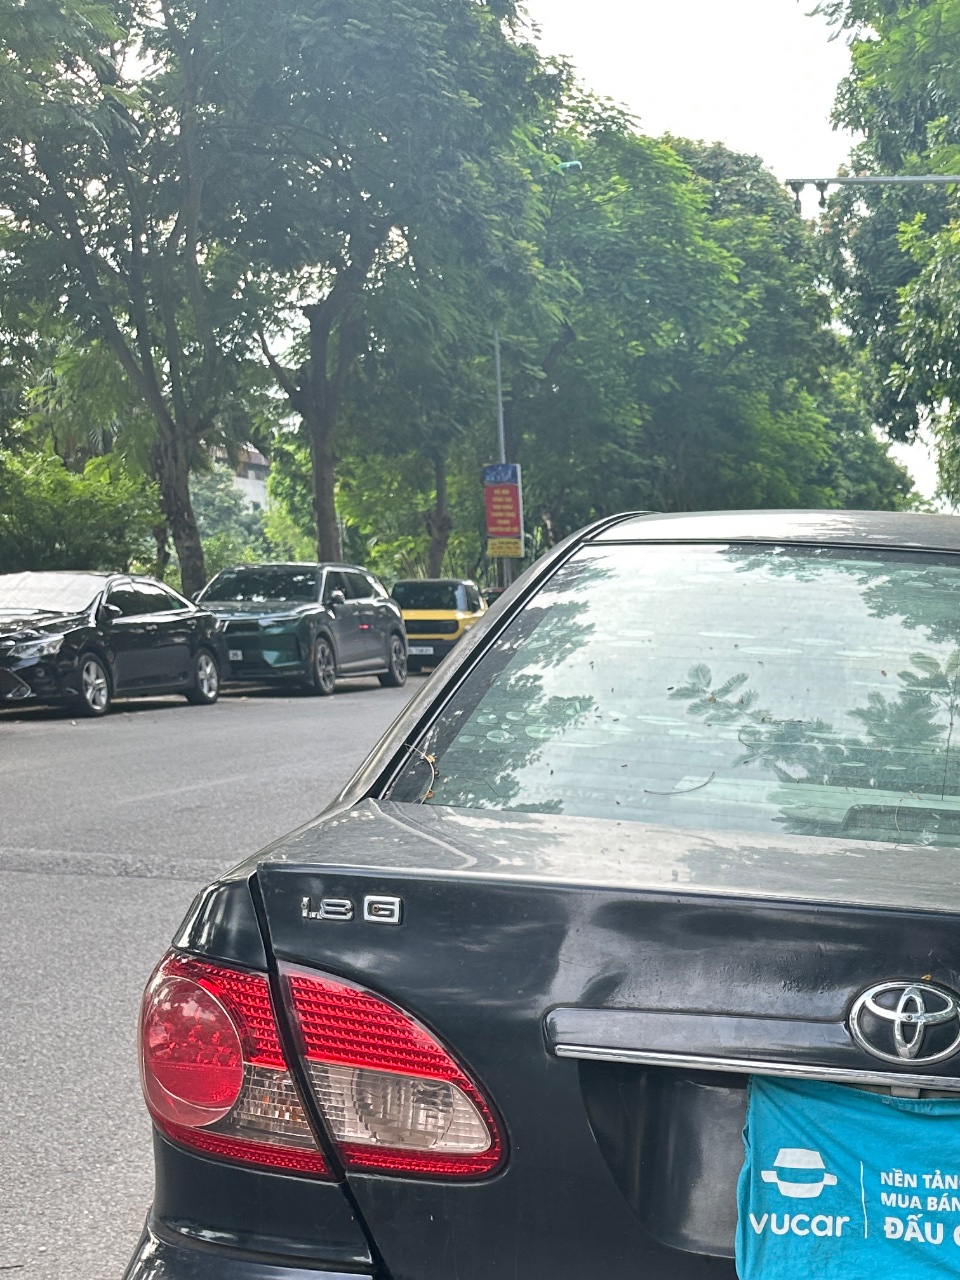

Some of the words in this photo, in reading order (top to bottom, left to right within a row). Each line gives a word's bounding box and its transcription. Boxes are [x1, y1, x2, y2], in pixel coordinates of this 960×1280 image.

[301, 896, 354, 920] 1.8
[363, 895, 401, 923] G
[880, 1168, 918, 1190] NỀN
[880, 1192, 922, 1210] MUA
[749, 1212, 850, 1238] vucar
[883, 1213, 944, 1246] ĐẤU
